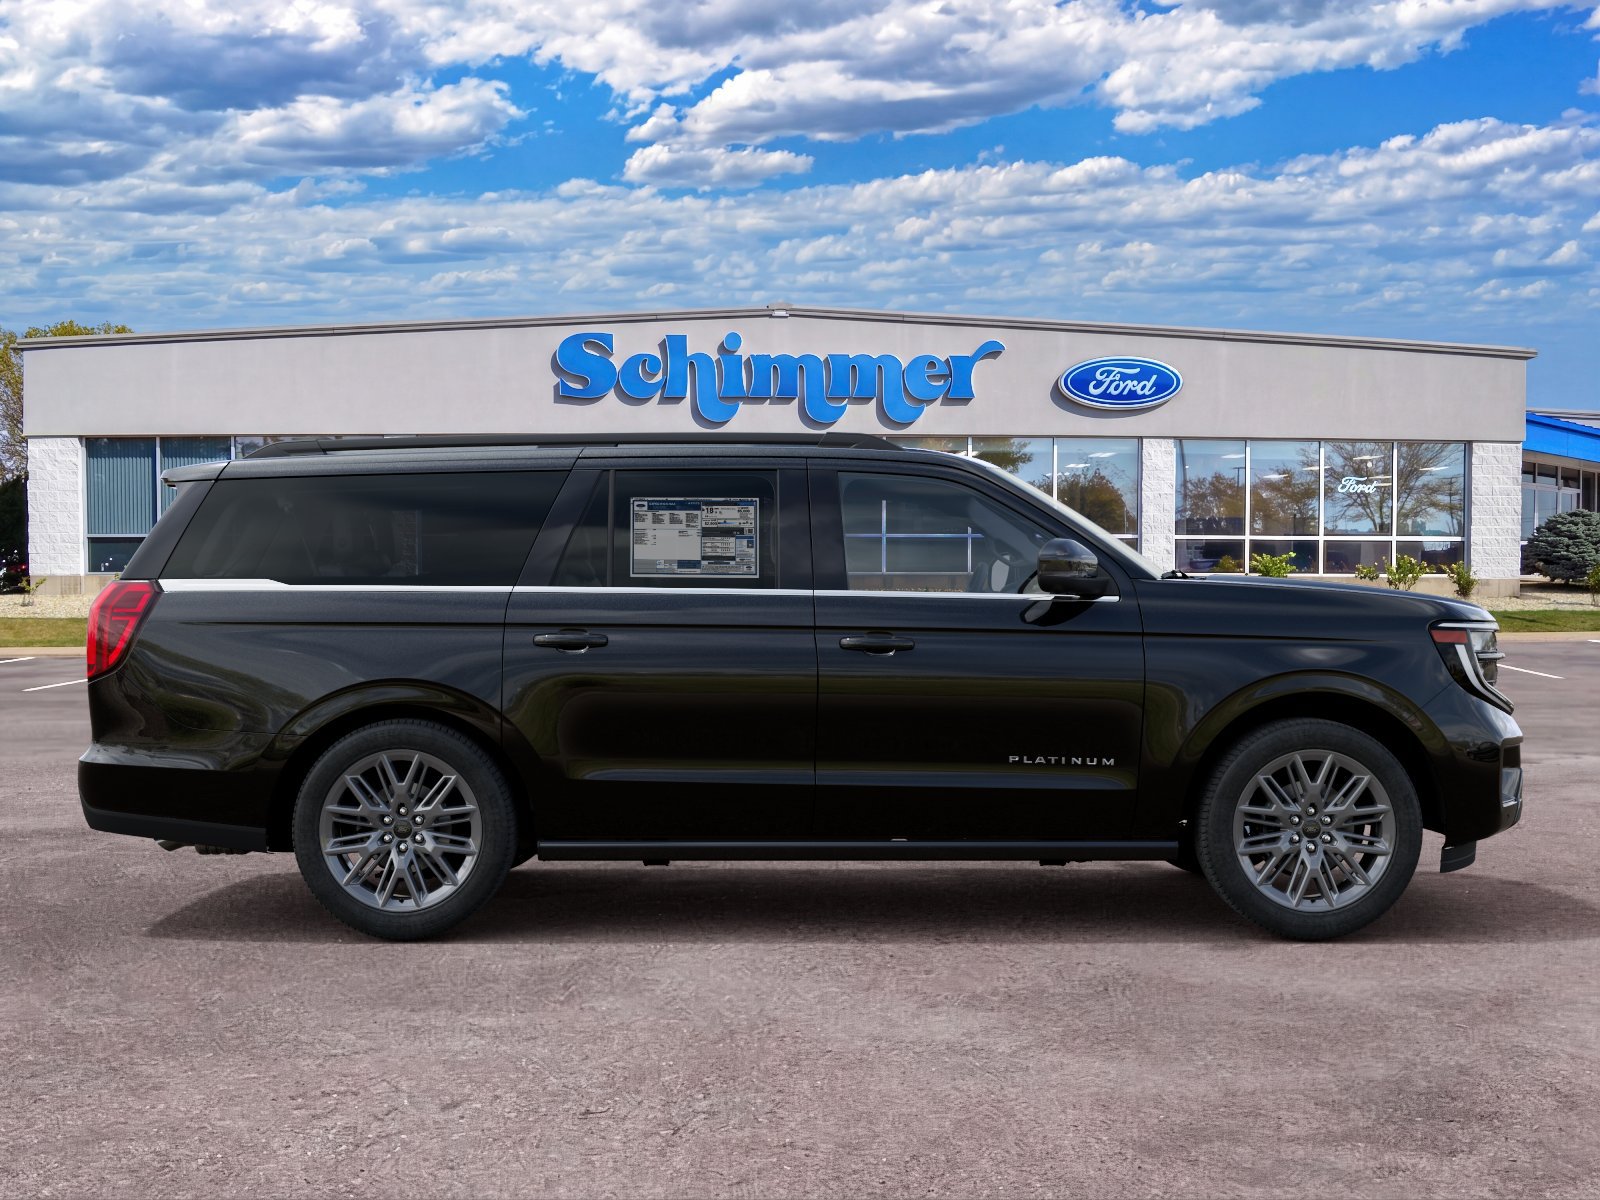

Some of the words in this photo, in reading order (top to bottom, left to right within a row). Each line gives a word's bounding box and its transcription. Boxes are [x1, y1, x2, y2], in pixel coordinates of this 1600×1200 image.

[556, 331, 1006, 423] Schimmer
[1088, 366, 1158, 396] Ford
[1337, 476, 1378, 494] Ford
[1008, 755, 1115, 766] PLATINUM
